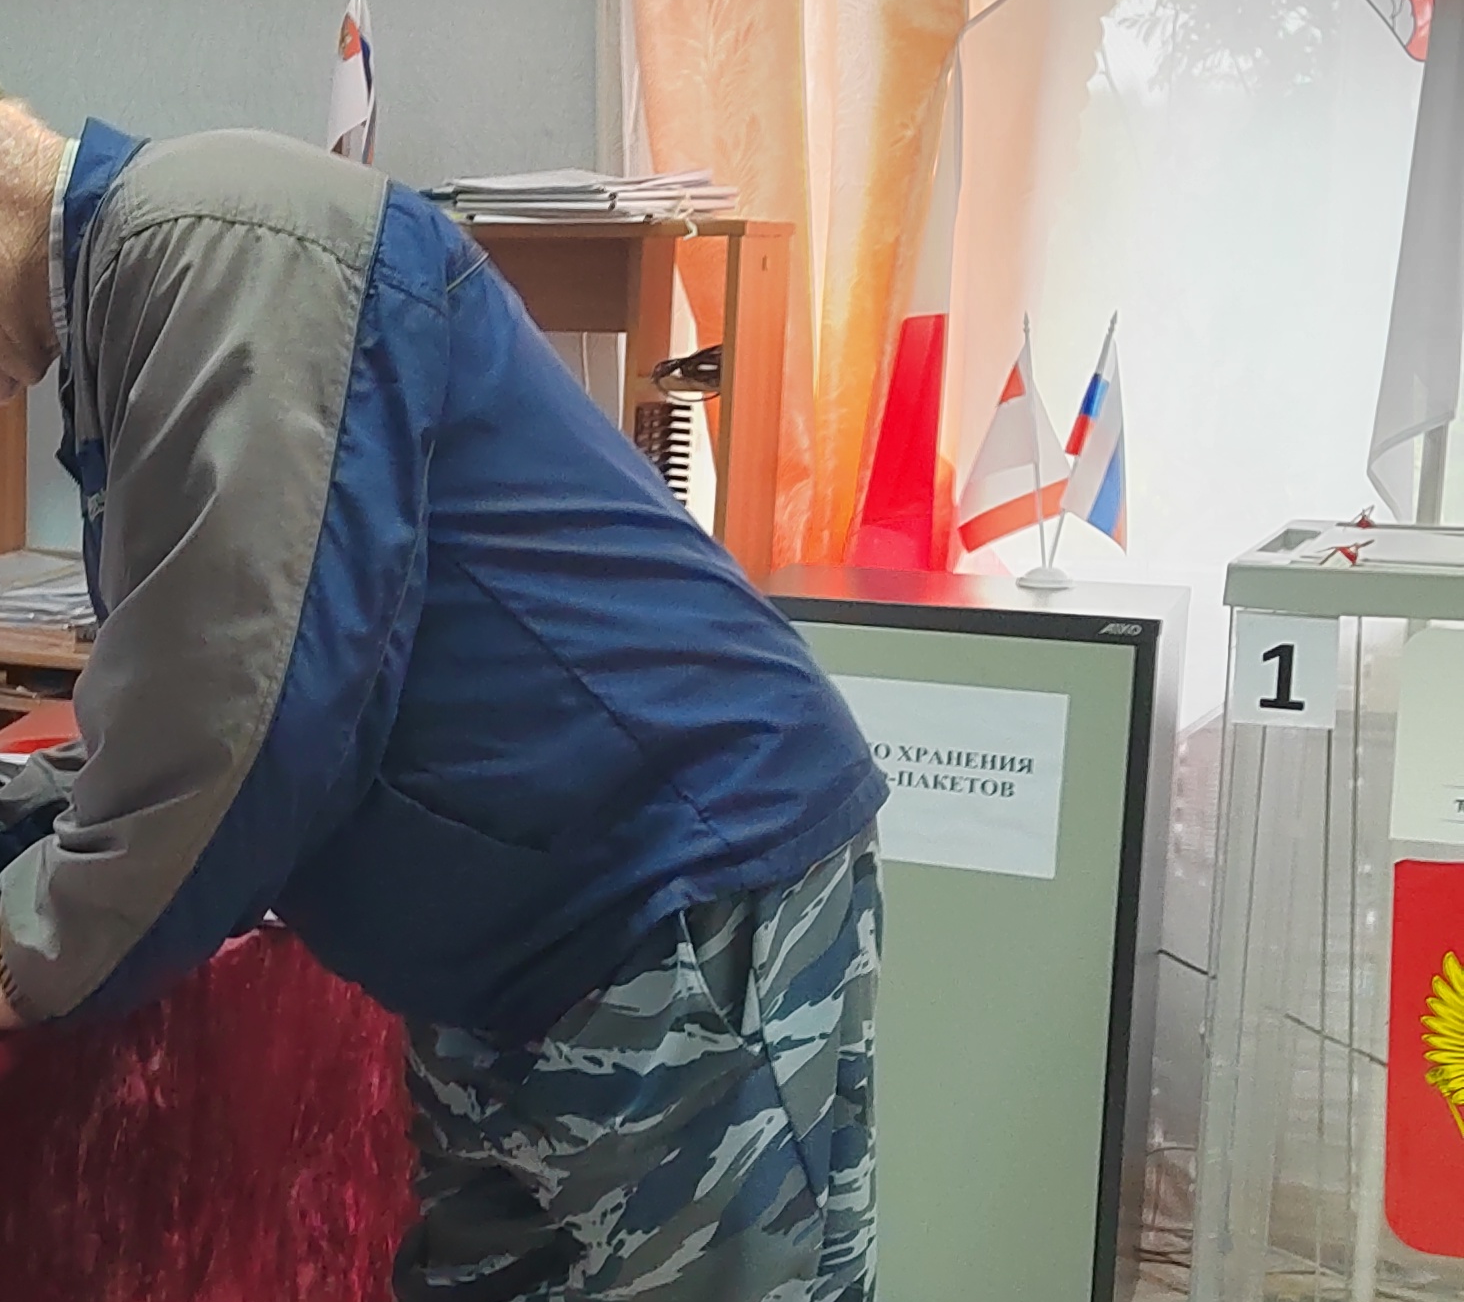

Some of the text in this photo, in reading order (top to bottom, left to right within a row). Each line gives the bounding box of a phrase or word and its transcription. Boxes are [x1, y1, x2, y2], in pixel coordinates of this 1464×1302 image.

[1259, 643, 1306, 712] 1
[869, 741, 1034, 775] О ХРАНЕНИЯ
[885, 770, 1015, 798] -ПАКЕТОВ
